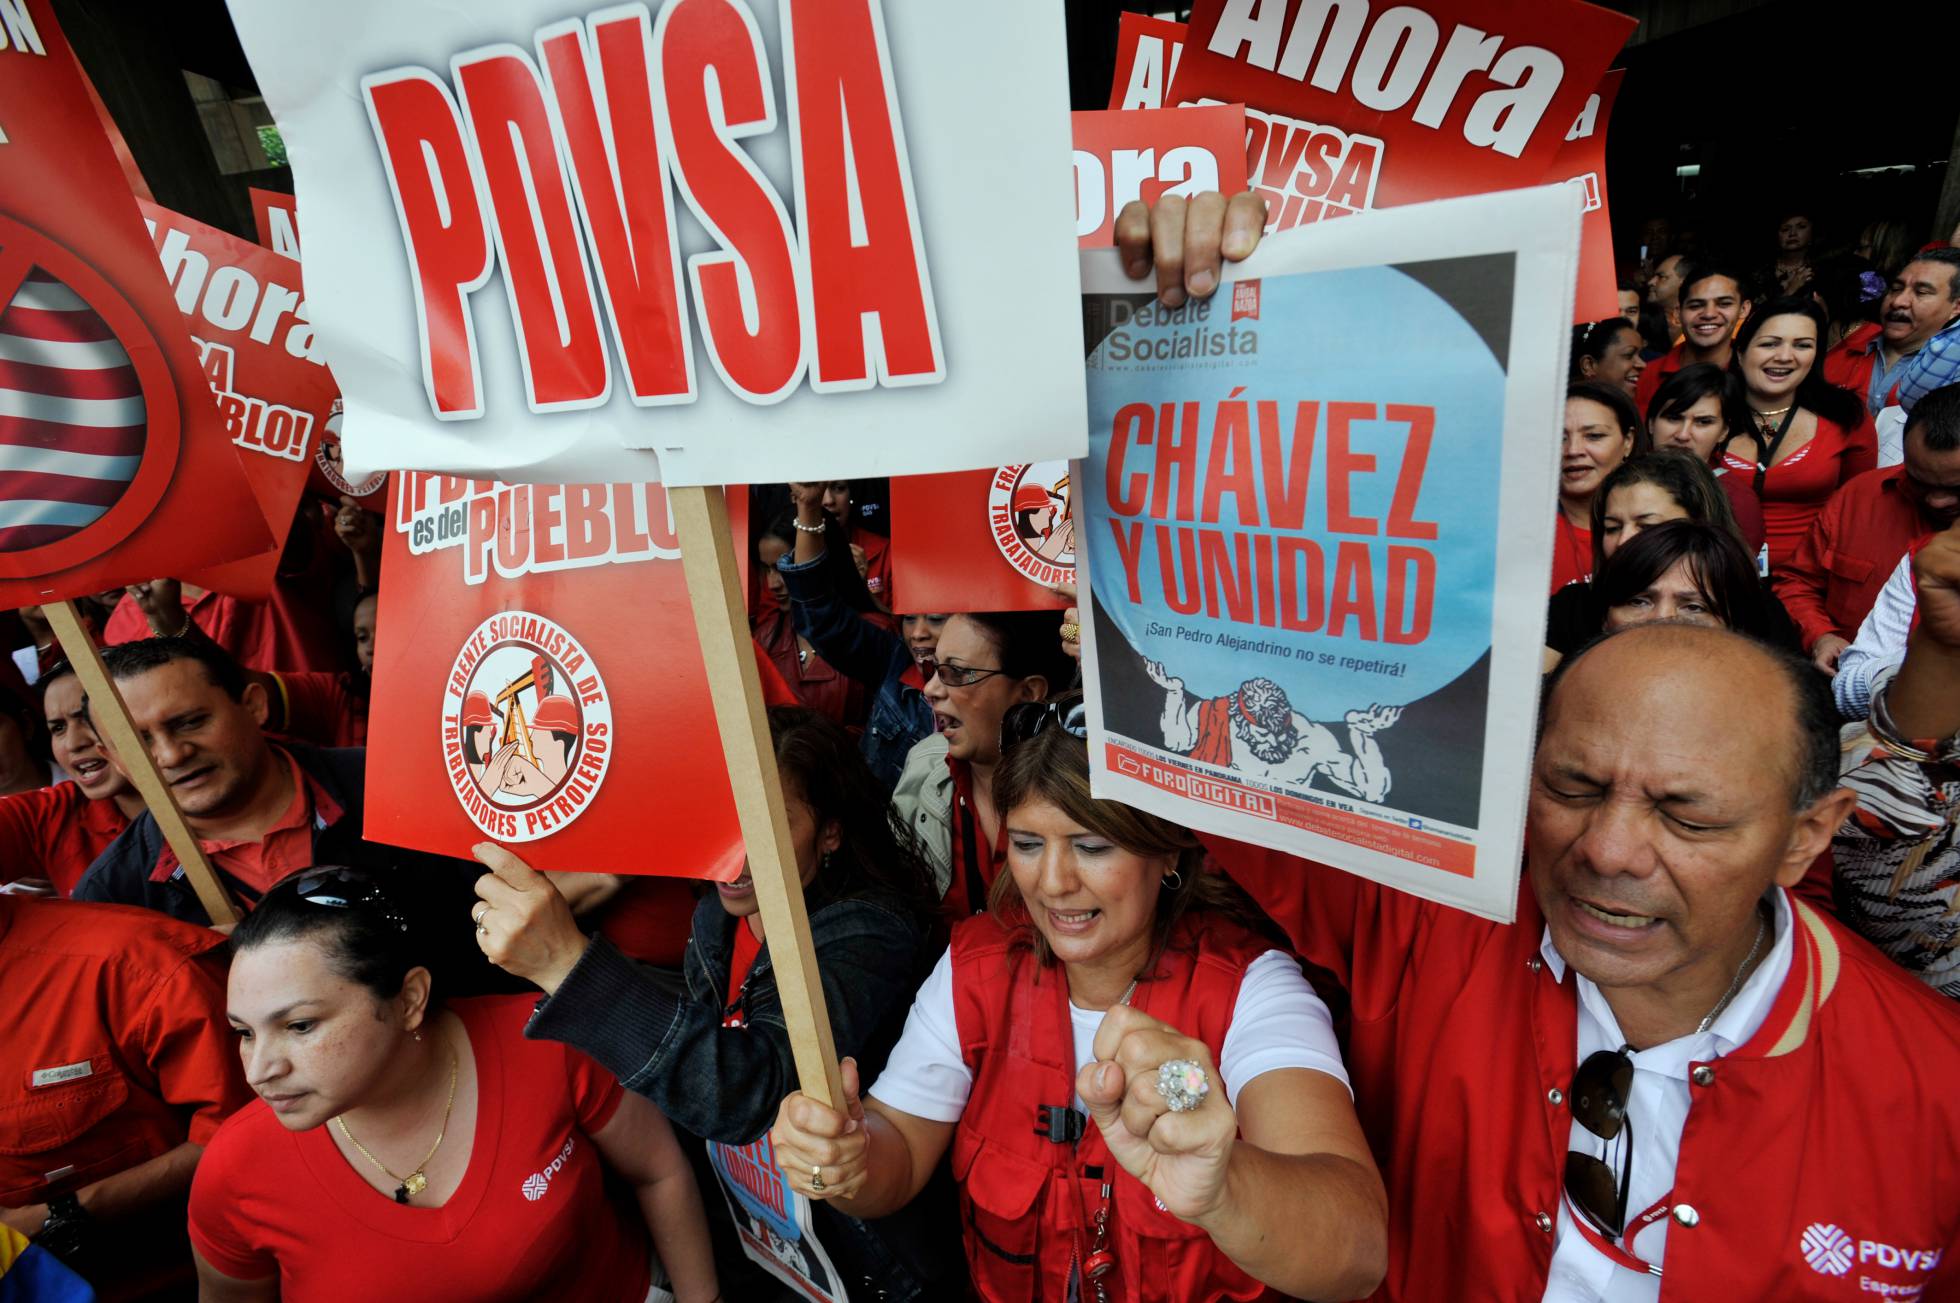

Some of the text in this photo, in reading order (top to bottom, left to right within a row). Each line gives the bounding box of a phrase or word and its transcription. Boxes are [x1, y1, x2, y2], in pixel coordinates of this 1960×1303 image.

[1207, 0, 1565, 159] Ahora
[364, 0, 942, 416] PDVSA
[144, 218, 328, 367] hora
[1110, 299, 1211, 327] Debate
[1109, 326, 1258, 361] Socialista
[1105, 386, 1439, 540] CHÁVEZ
[413, 516, 434, 547] es
[438, 502, 467, 537] del
[1108, 517, 1437, 645] Y UNIDAD
[449, 616, 604, 708] FRENTE SOCIALISTA DE
[1145, 622, 1407, 678] ¡San Pedro Alejandrino no se repetirá!
[445, 714, 609, 837] TRABAJADORES PETROLEROS
[1141, 763, 1187, 792] FORO
[1190, 778, 1273, 815] DIGITAL
[1155, 753, 1167, 764] LOS
[1168, 757, 1193, 771] VIERNES
[1194, 764, 1203, 773] EN
[1269, 785, 1283, 794] LOS
[1326, 799, 1336, 808] EN
[1338, 803, 1354, 812] VEA
